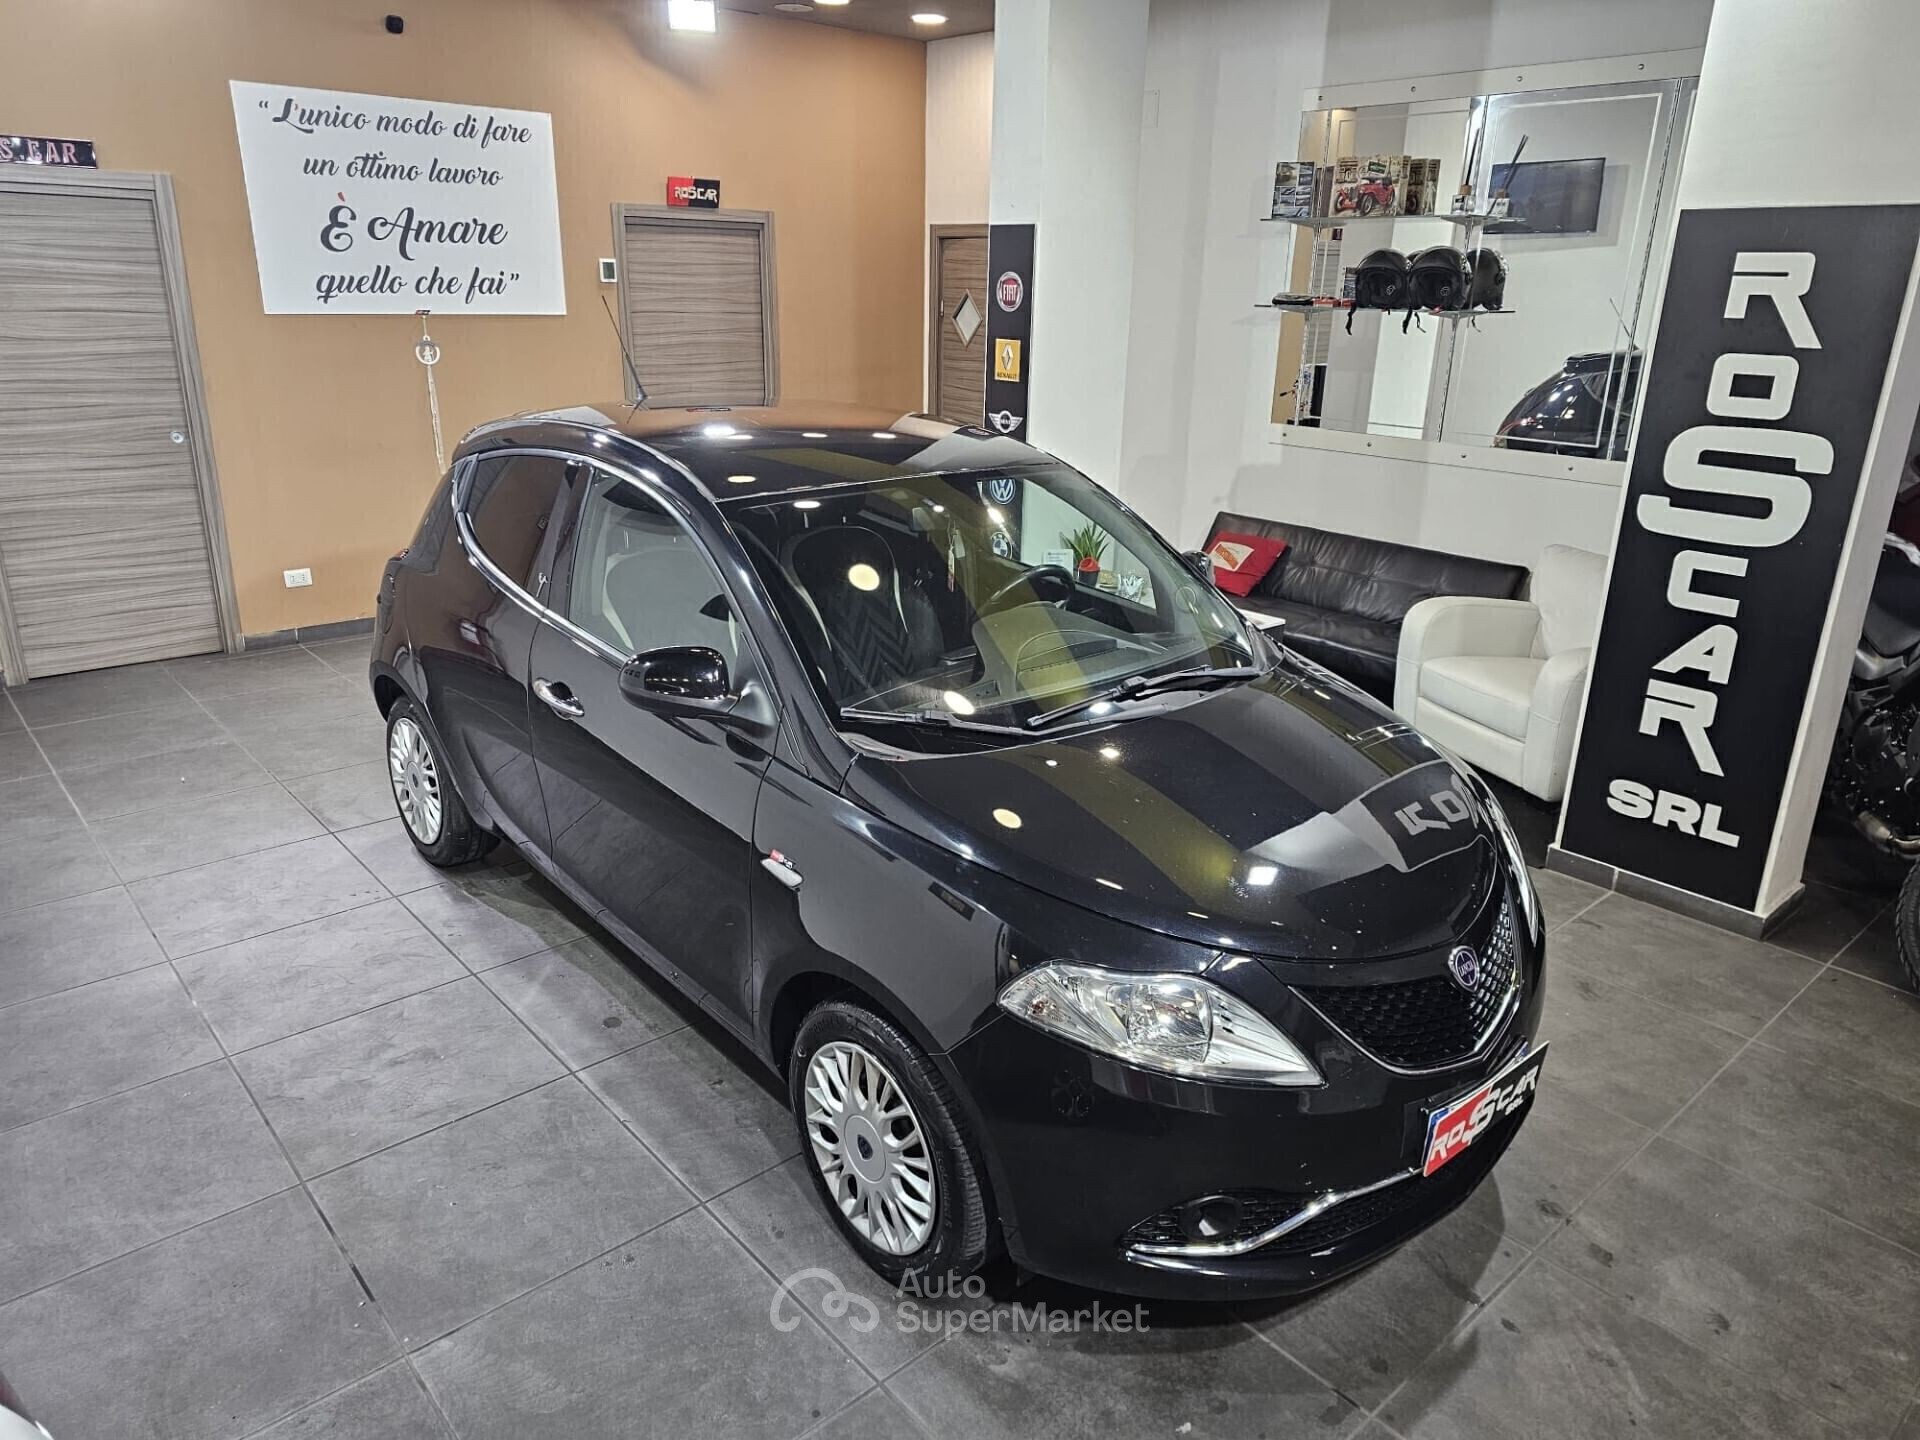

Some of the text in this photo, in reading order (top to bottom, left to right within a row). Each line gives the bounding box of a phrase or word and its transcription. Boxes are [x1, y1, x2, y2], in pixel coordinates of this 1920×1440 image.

[376, 110, 447, 136] modo
[453, 113, 479, 139] di
[481, 116, 532, 149] fare
[303, 151, 503, 186] un ottimo lavoro
[320, 192, 508, 261] È Amare
[316, 264, 408, 304] quello
[414, 266, 462, 295] che
[1003, 284, 1017, 301] FIAT
[1606, 778, 1741, 849] SRL
